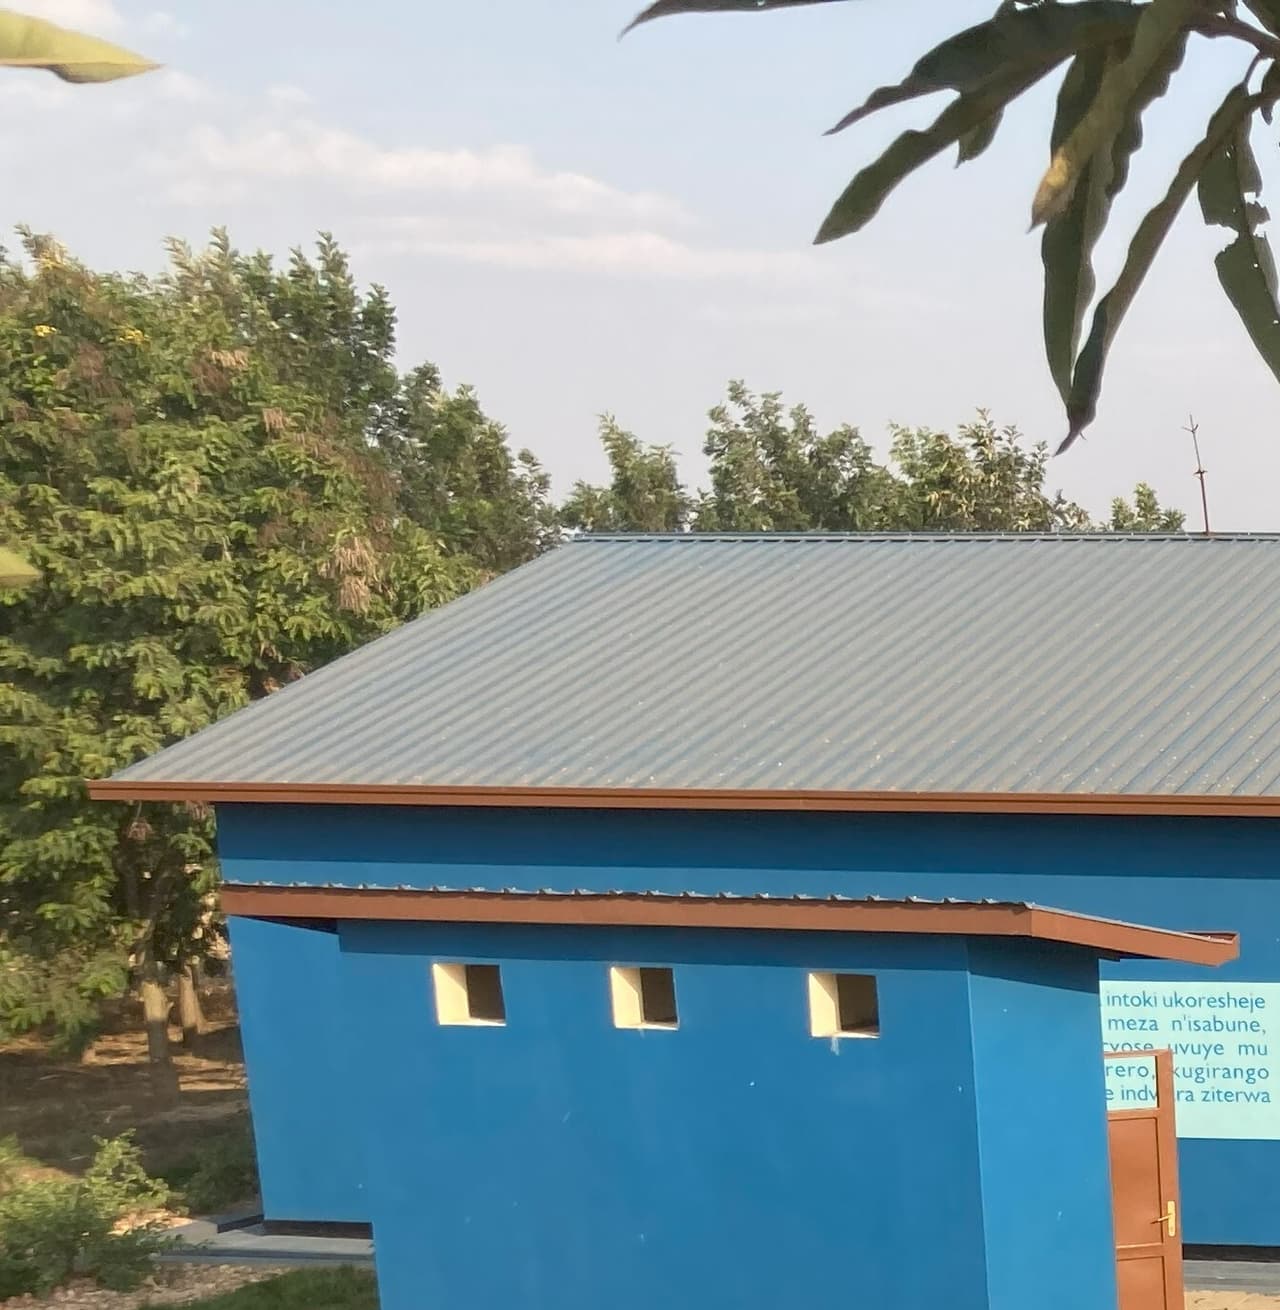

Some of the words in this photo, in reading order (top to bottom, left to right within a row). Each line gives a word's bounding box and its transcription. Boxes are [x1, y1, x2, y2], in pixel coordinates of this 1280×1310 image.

[1106, 990, 1158, 1008] intoki
[1162, 991, 1266, 1014] ukoresheje
[1108, 1018, 1159, 1031] meza
[1172, 1015, 1266, 1035] n'isabune,
[1238, 1043, 1268, 1056] mu
[1201, 1086, 1271, 1103] ziterwa
